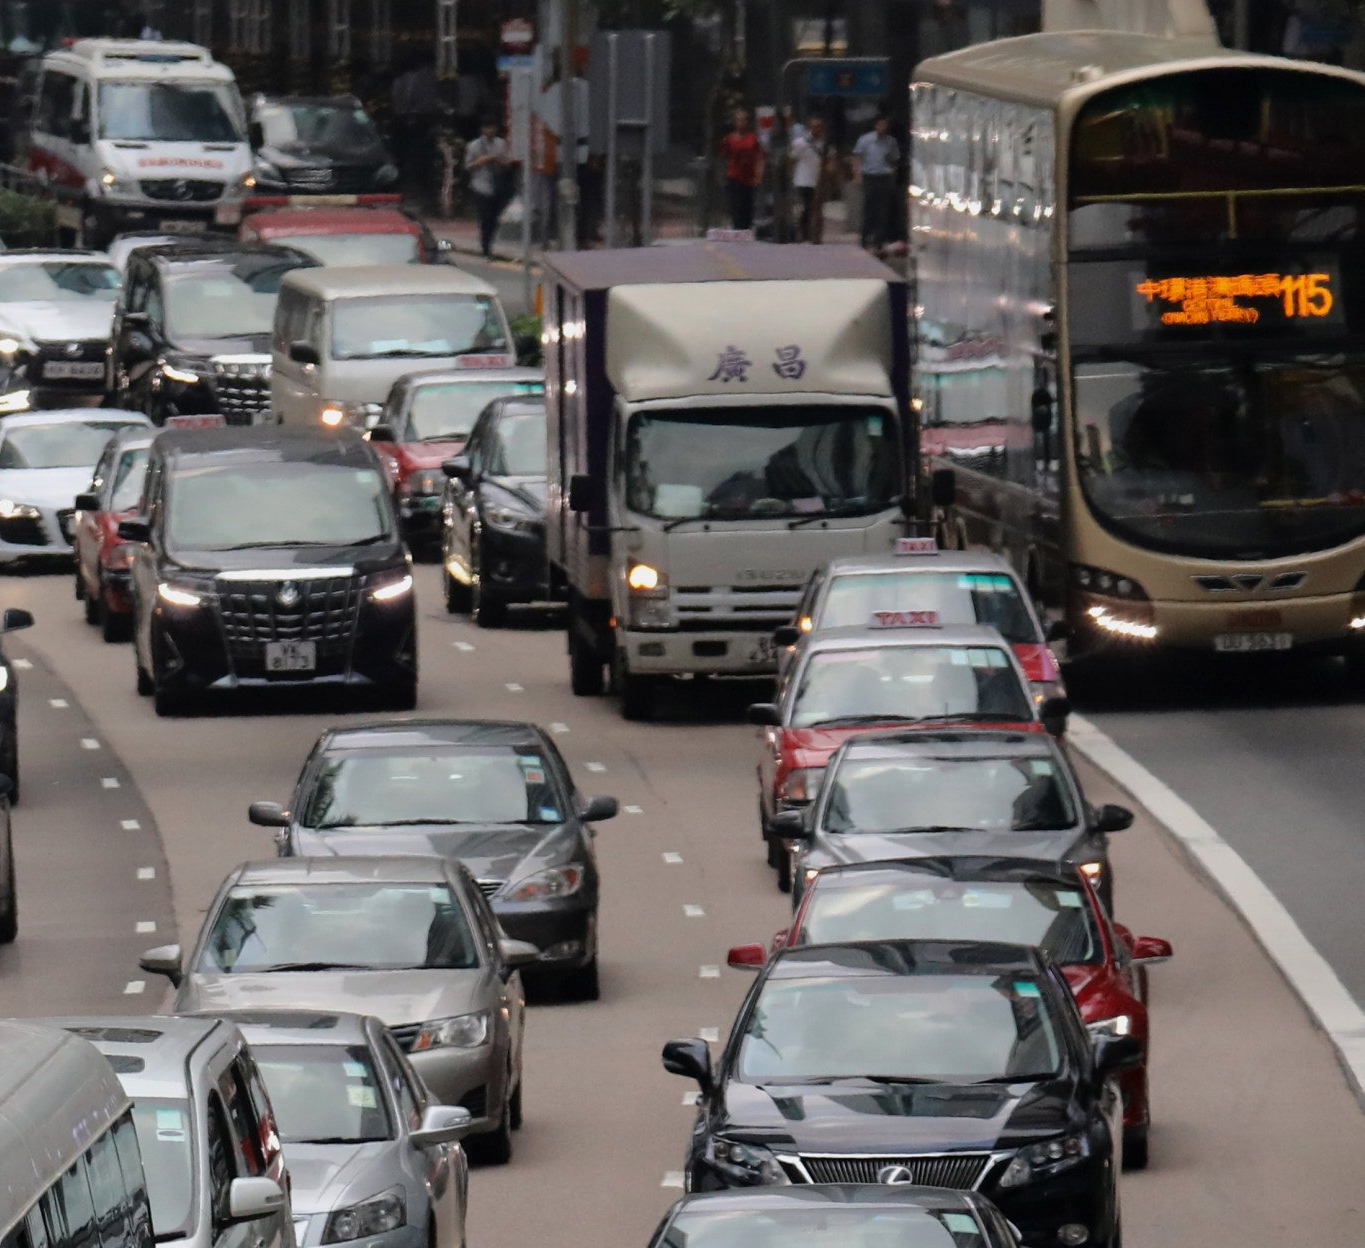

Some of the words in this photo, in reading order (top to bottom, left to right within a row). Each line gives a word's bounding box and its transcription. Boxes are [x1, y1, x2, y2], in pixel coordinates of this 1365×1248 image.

[1280, 273, 1333, 317] 115
[708, 345, 807, 383] 廣昌
[875, 611, 937, 625] TAXI
